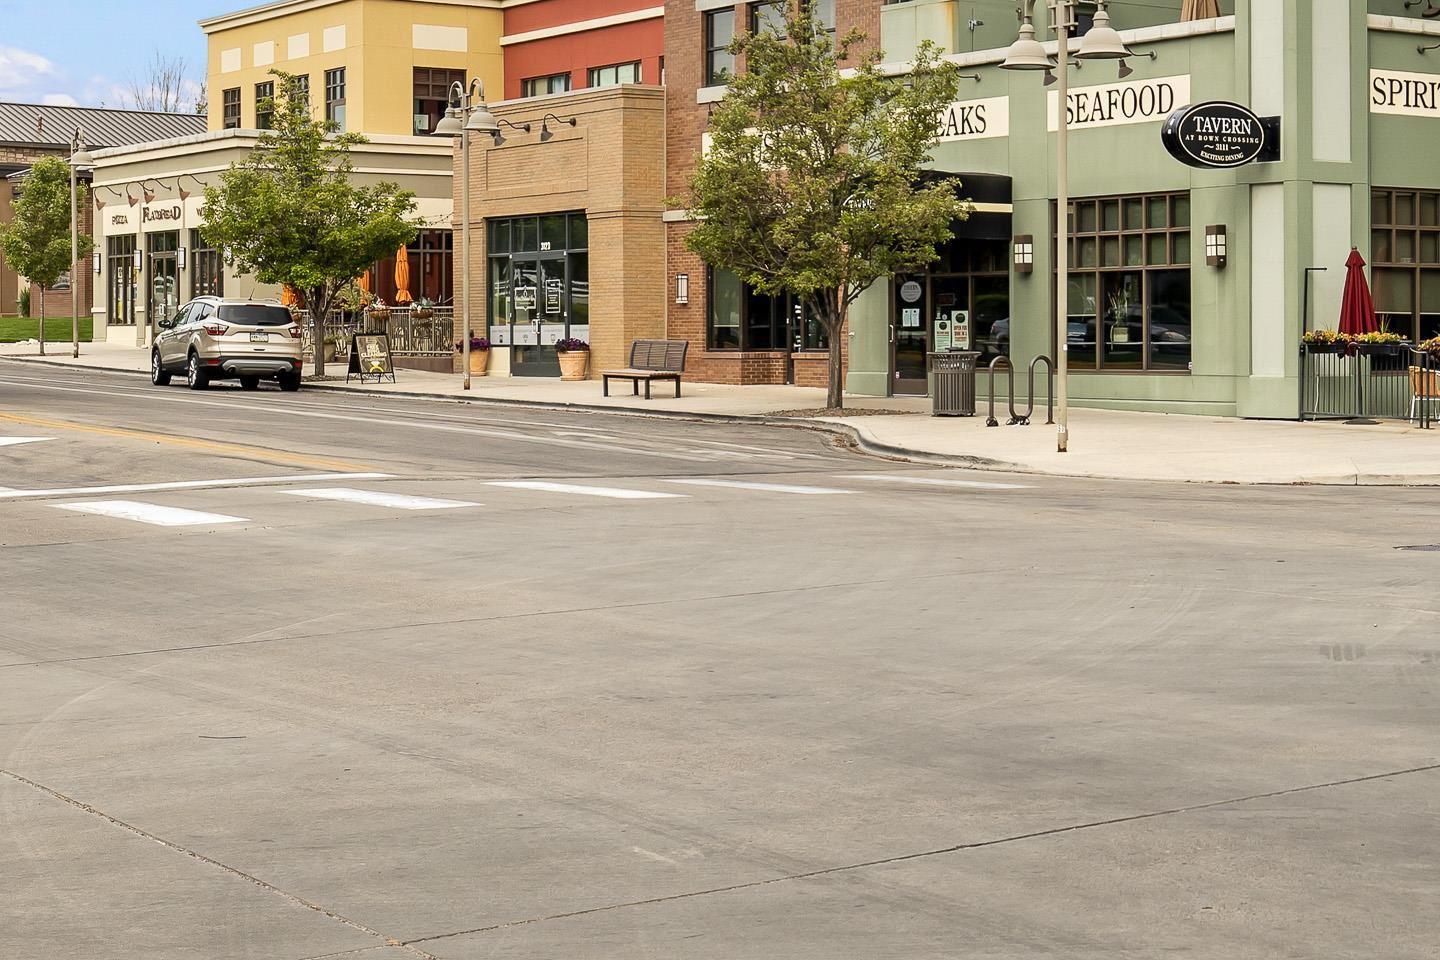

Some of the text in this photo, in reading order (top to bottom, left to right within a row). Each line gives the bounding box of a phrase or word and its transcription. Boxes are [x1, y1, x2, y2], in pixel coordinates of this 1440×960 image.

[1066, 83, 1174, 125] SEAFOOD
[932, 104, 987, 138] EAKS
[1193, 116, 1252, 135] TAVERN
[1222, 136, 1259, 144] CROSSING
[1215, 143, 1229, 151] 3111
[1200, 150, 1244, 161] EXCITING DINING
[112, 214, 128, 225] PIZZA
